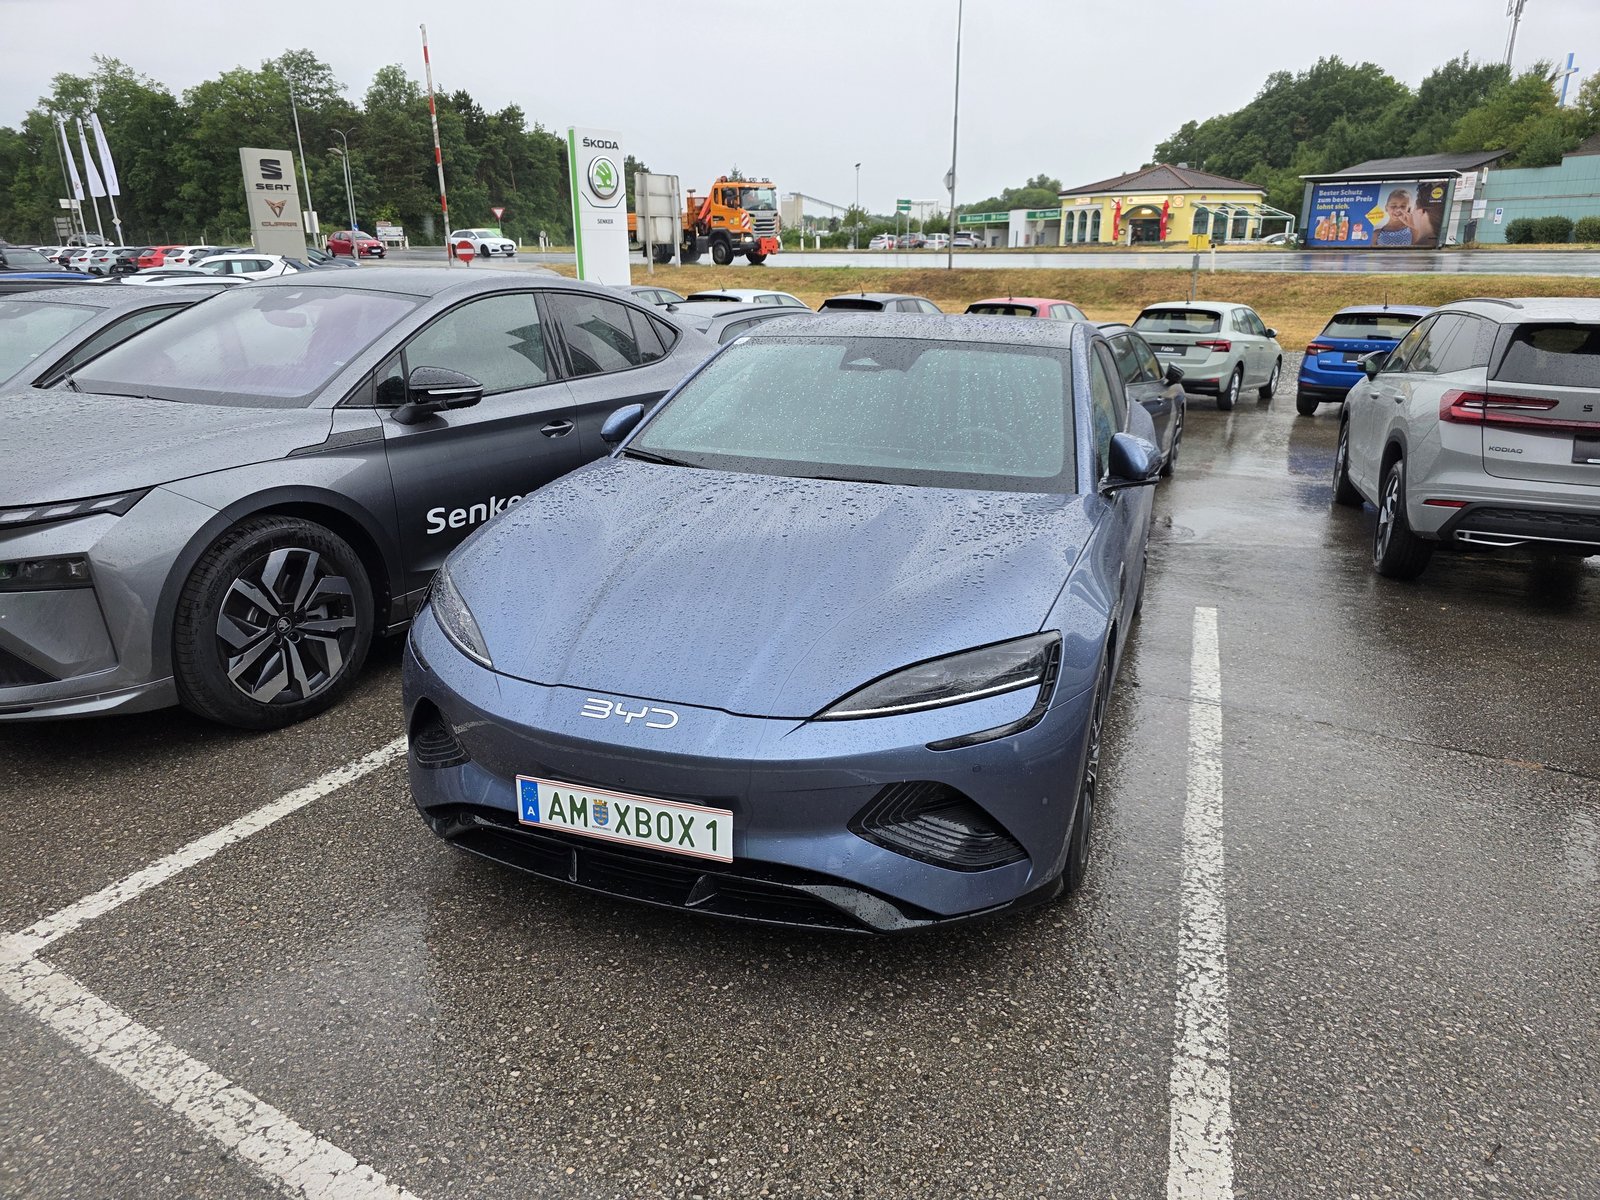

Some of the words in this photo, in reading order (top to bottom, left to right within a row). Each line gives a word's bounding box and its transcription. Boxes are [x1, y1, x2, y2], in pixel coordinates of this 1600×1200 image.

[582, 137, 619, 150] ŠKODA
[256, 183, 291, 191] SEAT
[1488, 446, 1524, 454] KODIAQ
[580, 697, 679, 729] BYD
[527, 806, 536, 816] A
[548, 791, 588, 828] AM
[613, 802, 696, 848] XBOX
[705, 819, 718, 852] 1
